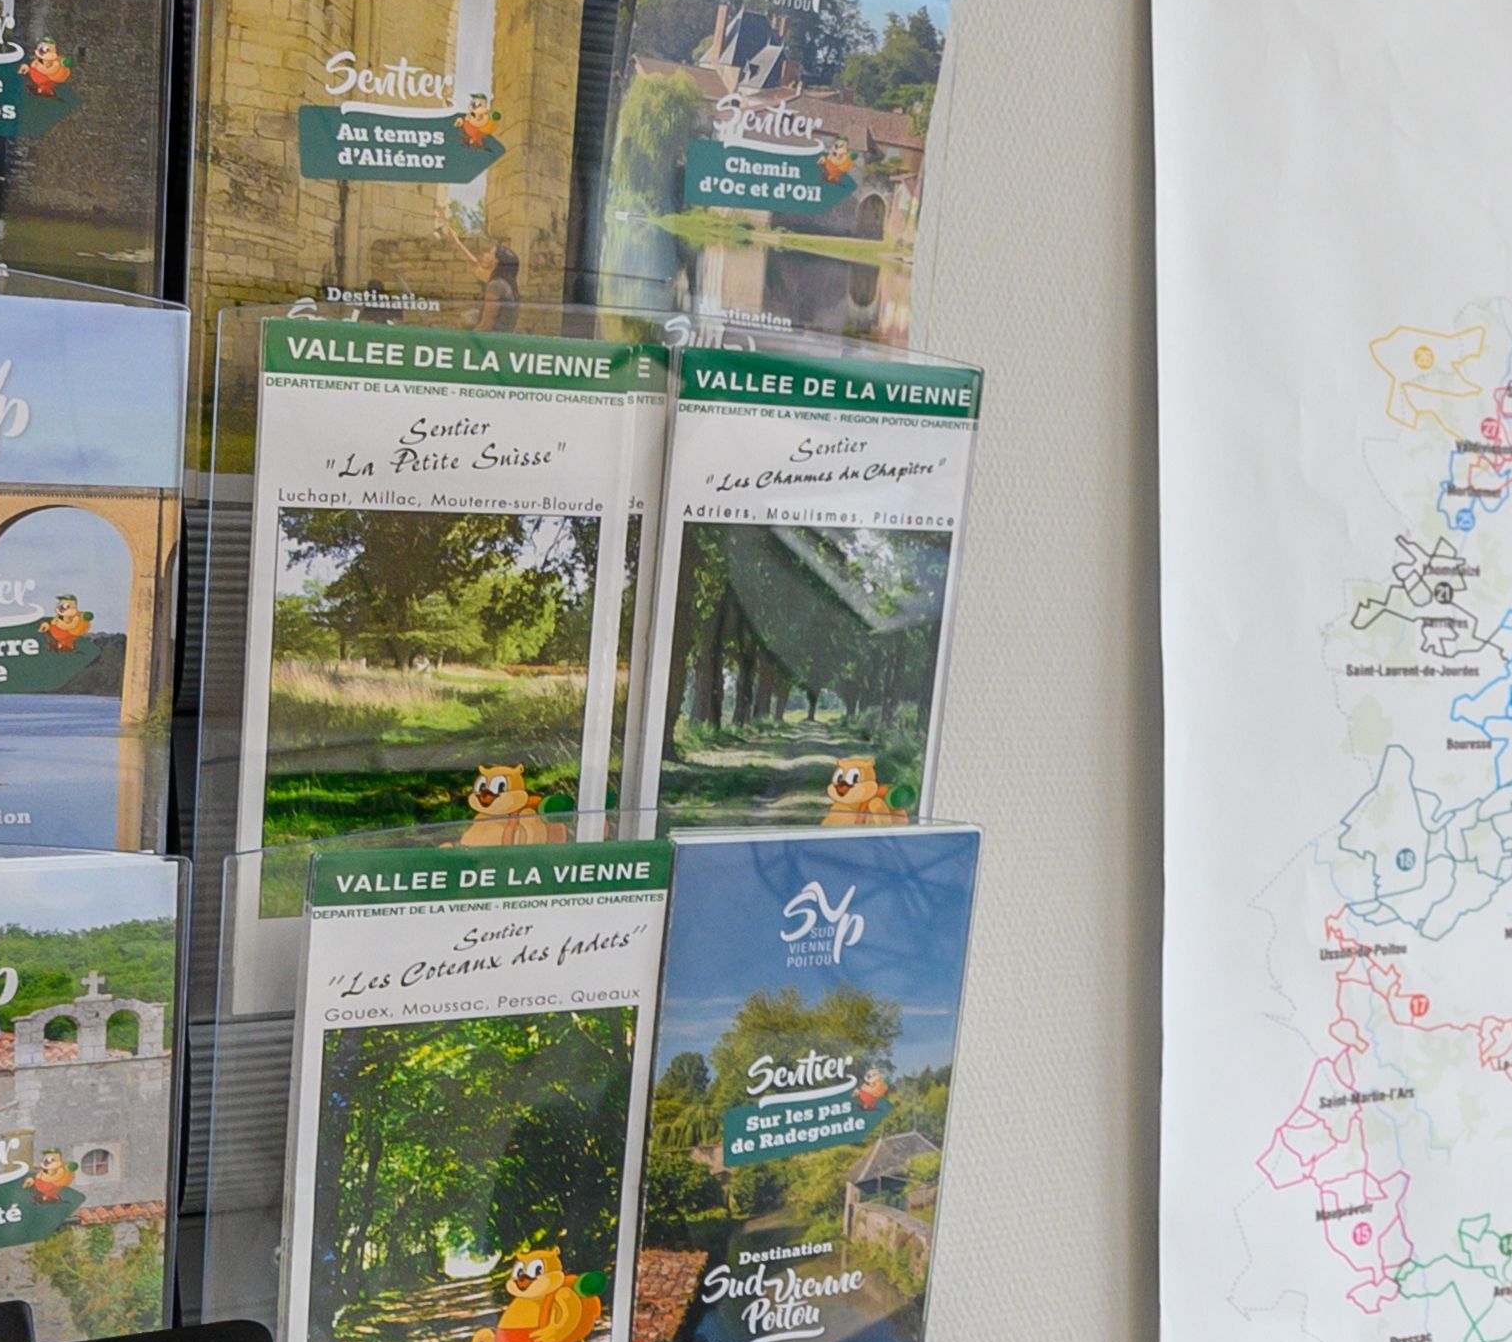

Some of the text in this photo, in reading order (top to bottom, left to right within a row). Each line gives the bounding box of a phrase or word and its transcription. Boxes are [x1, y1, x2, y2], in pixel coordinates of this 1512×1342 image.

[325, 51, 455, 100] Sentier
[713, 93, 823, 139] Sentier
[336, 123, 444, 147] Au temps
[338, 148, 445, 168] d'Aliénor
[725, 157, 800, 179] Chemin
[700, 177, 821, 202] d'Oc et d'Oïl
[287, 336, 611, 379] VALLEE DE LA VIENNE
[696, 370, 972, 407] VALLEE DE LA VIENNE
[399, 418, 491, 445] Sentier
[326, 453, 375, 478] "La
[390, 448, 459, 475] Petite
[790, 437, 868, 462] Sentier
[756, 469, 833, 489] Chaumes
[839, 465, 860, 481] du
[279, 488, 603, 511] Luchapt, Millac, Mouterre-sur-Blourde
[683, 504, 955, 527] Adriers, Moulismes, Plaisance
[1346, 664, 1480, 677] Saint-Laurent-de-Jourdes
[336, 862, 651, 893] VALLEE DE LA VIENNE
[453, 922, 534, 951] Sentier
[328, 925, 648, 997] "Les Coteaux des fadets"
[325, 987, 640, 1022] Gouex, Moussac, Persac, Queaux
[1412, 997, 1426, 1013] 17
[746, 1050, 853, 1096] Sentier
[746, 1101, 851, 1133] Sur les pas
[731, 1117, 866, 1154] de Radegonde
[1354, 1225, 1370, 1243] 15
[739, 1242, 832, 1265] Destination
[702, 1264, 864, 1303] Sud-Vienne
[741, 1298, 820, 1335] Poitou
